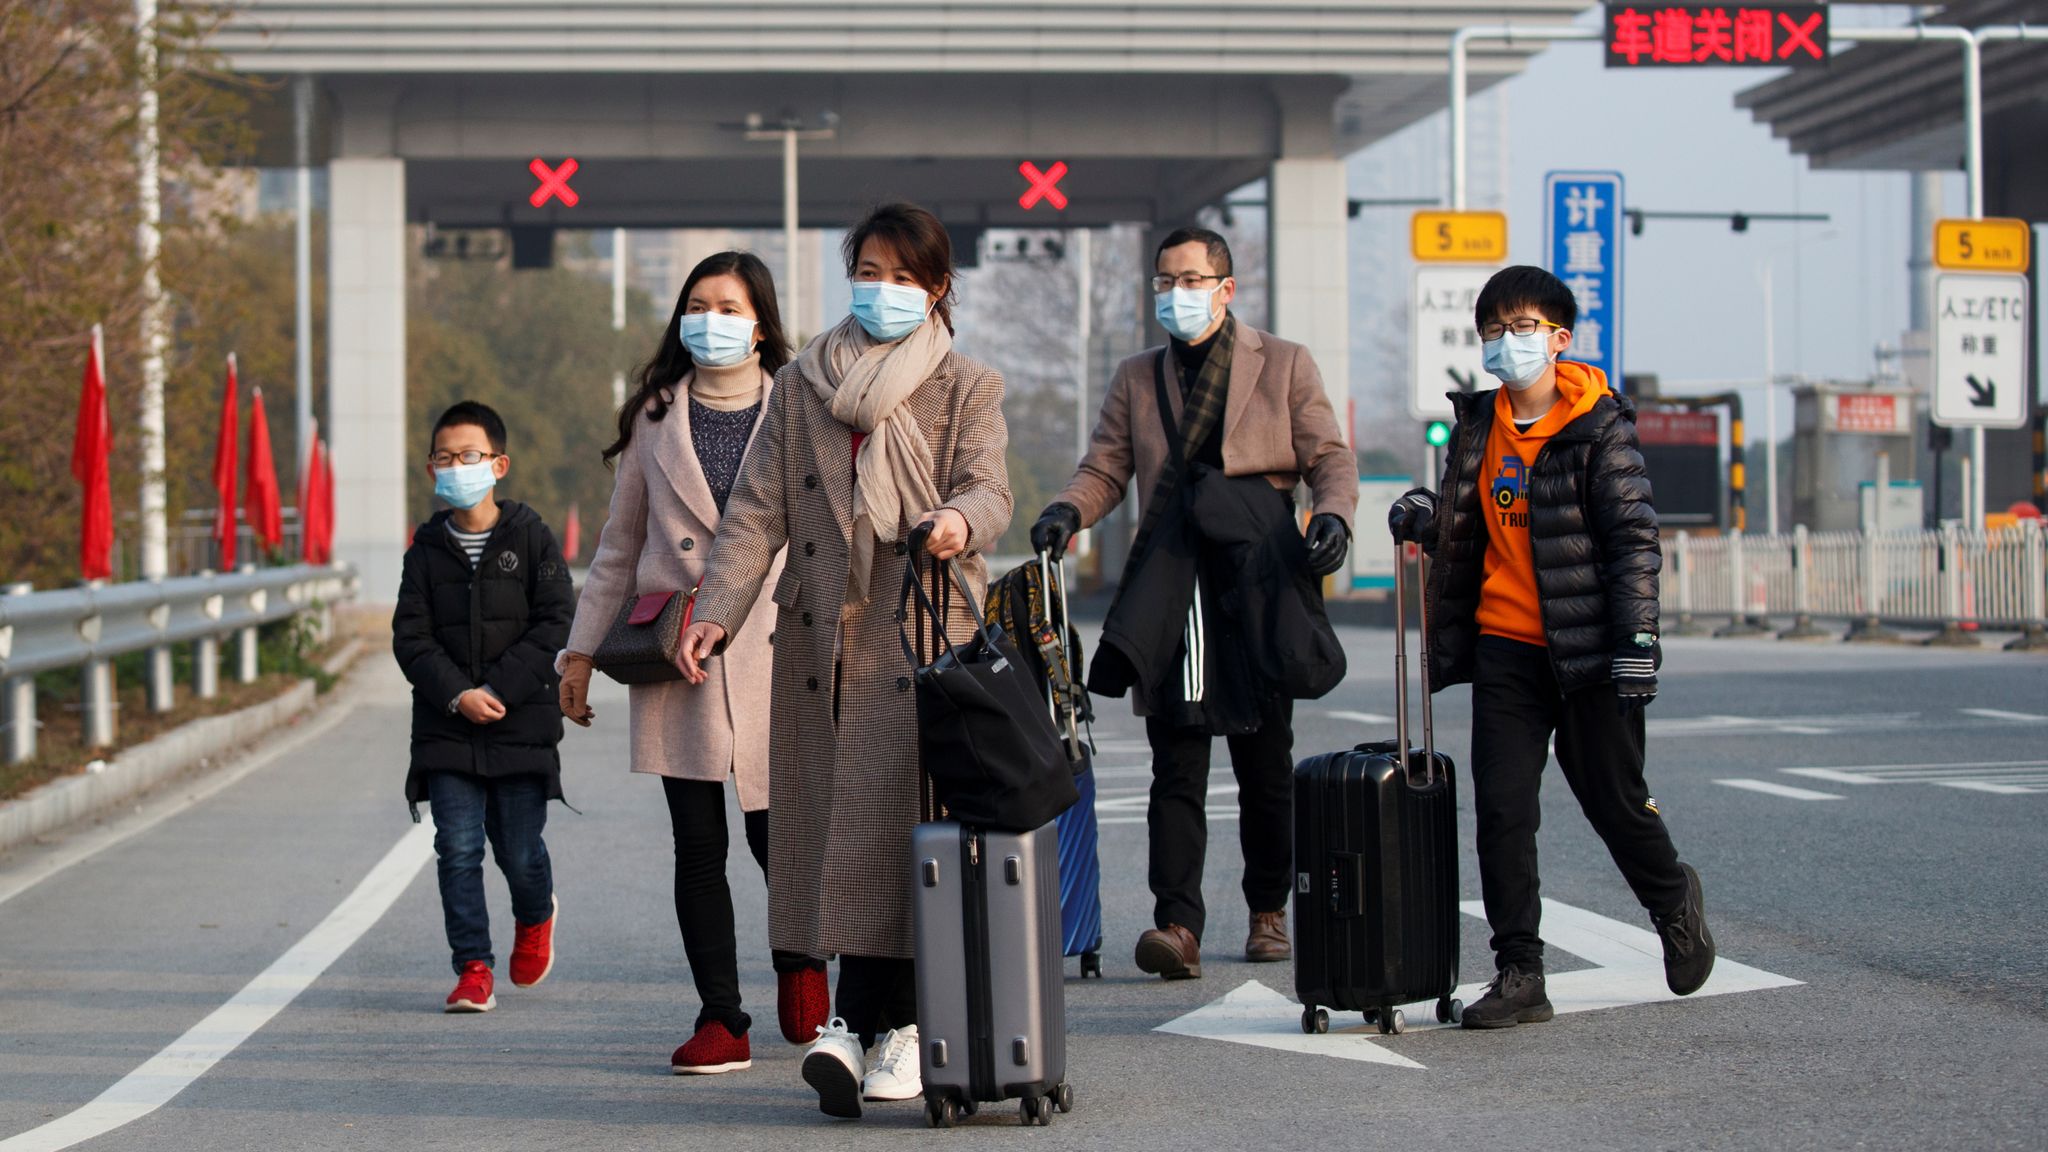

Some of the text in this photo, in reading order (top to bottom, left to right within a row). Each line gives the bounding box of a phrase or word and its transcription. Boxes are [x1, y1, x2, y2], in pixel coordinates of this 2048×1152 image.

[1611, 7, 1772, 65] 车道关闭
[1436, 222, 1453, 251] 5
[1957, 231, 1973, 259] 5
[1564, 184, 1605, 361] 计重车道
[1420, 288, 1478, 312] 人工/E
[1941, 296, 2021, 321] 人工/ETC
[1961, 333, 1998, 355] 称重
[1499, 512, 1528, 528] TRU
